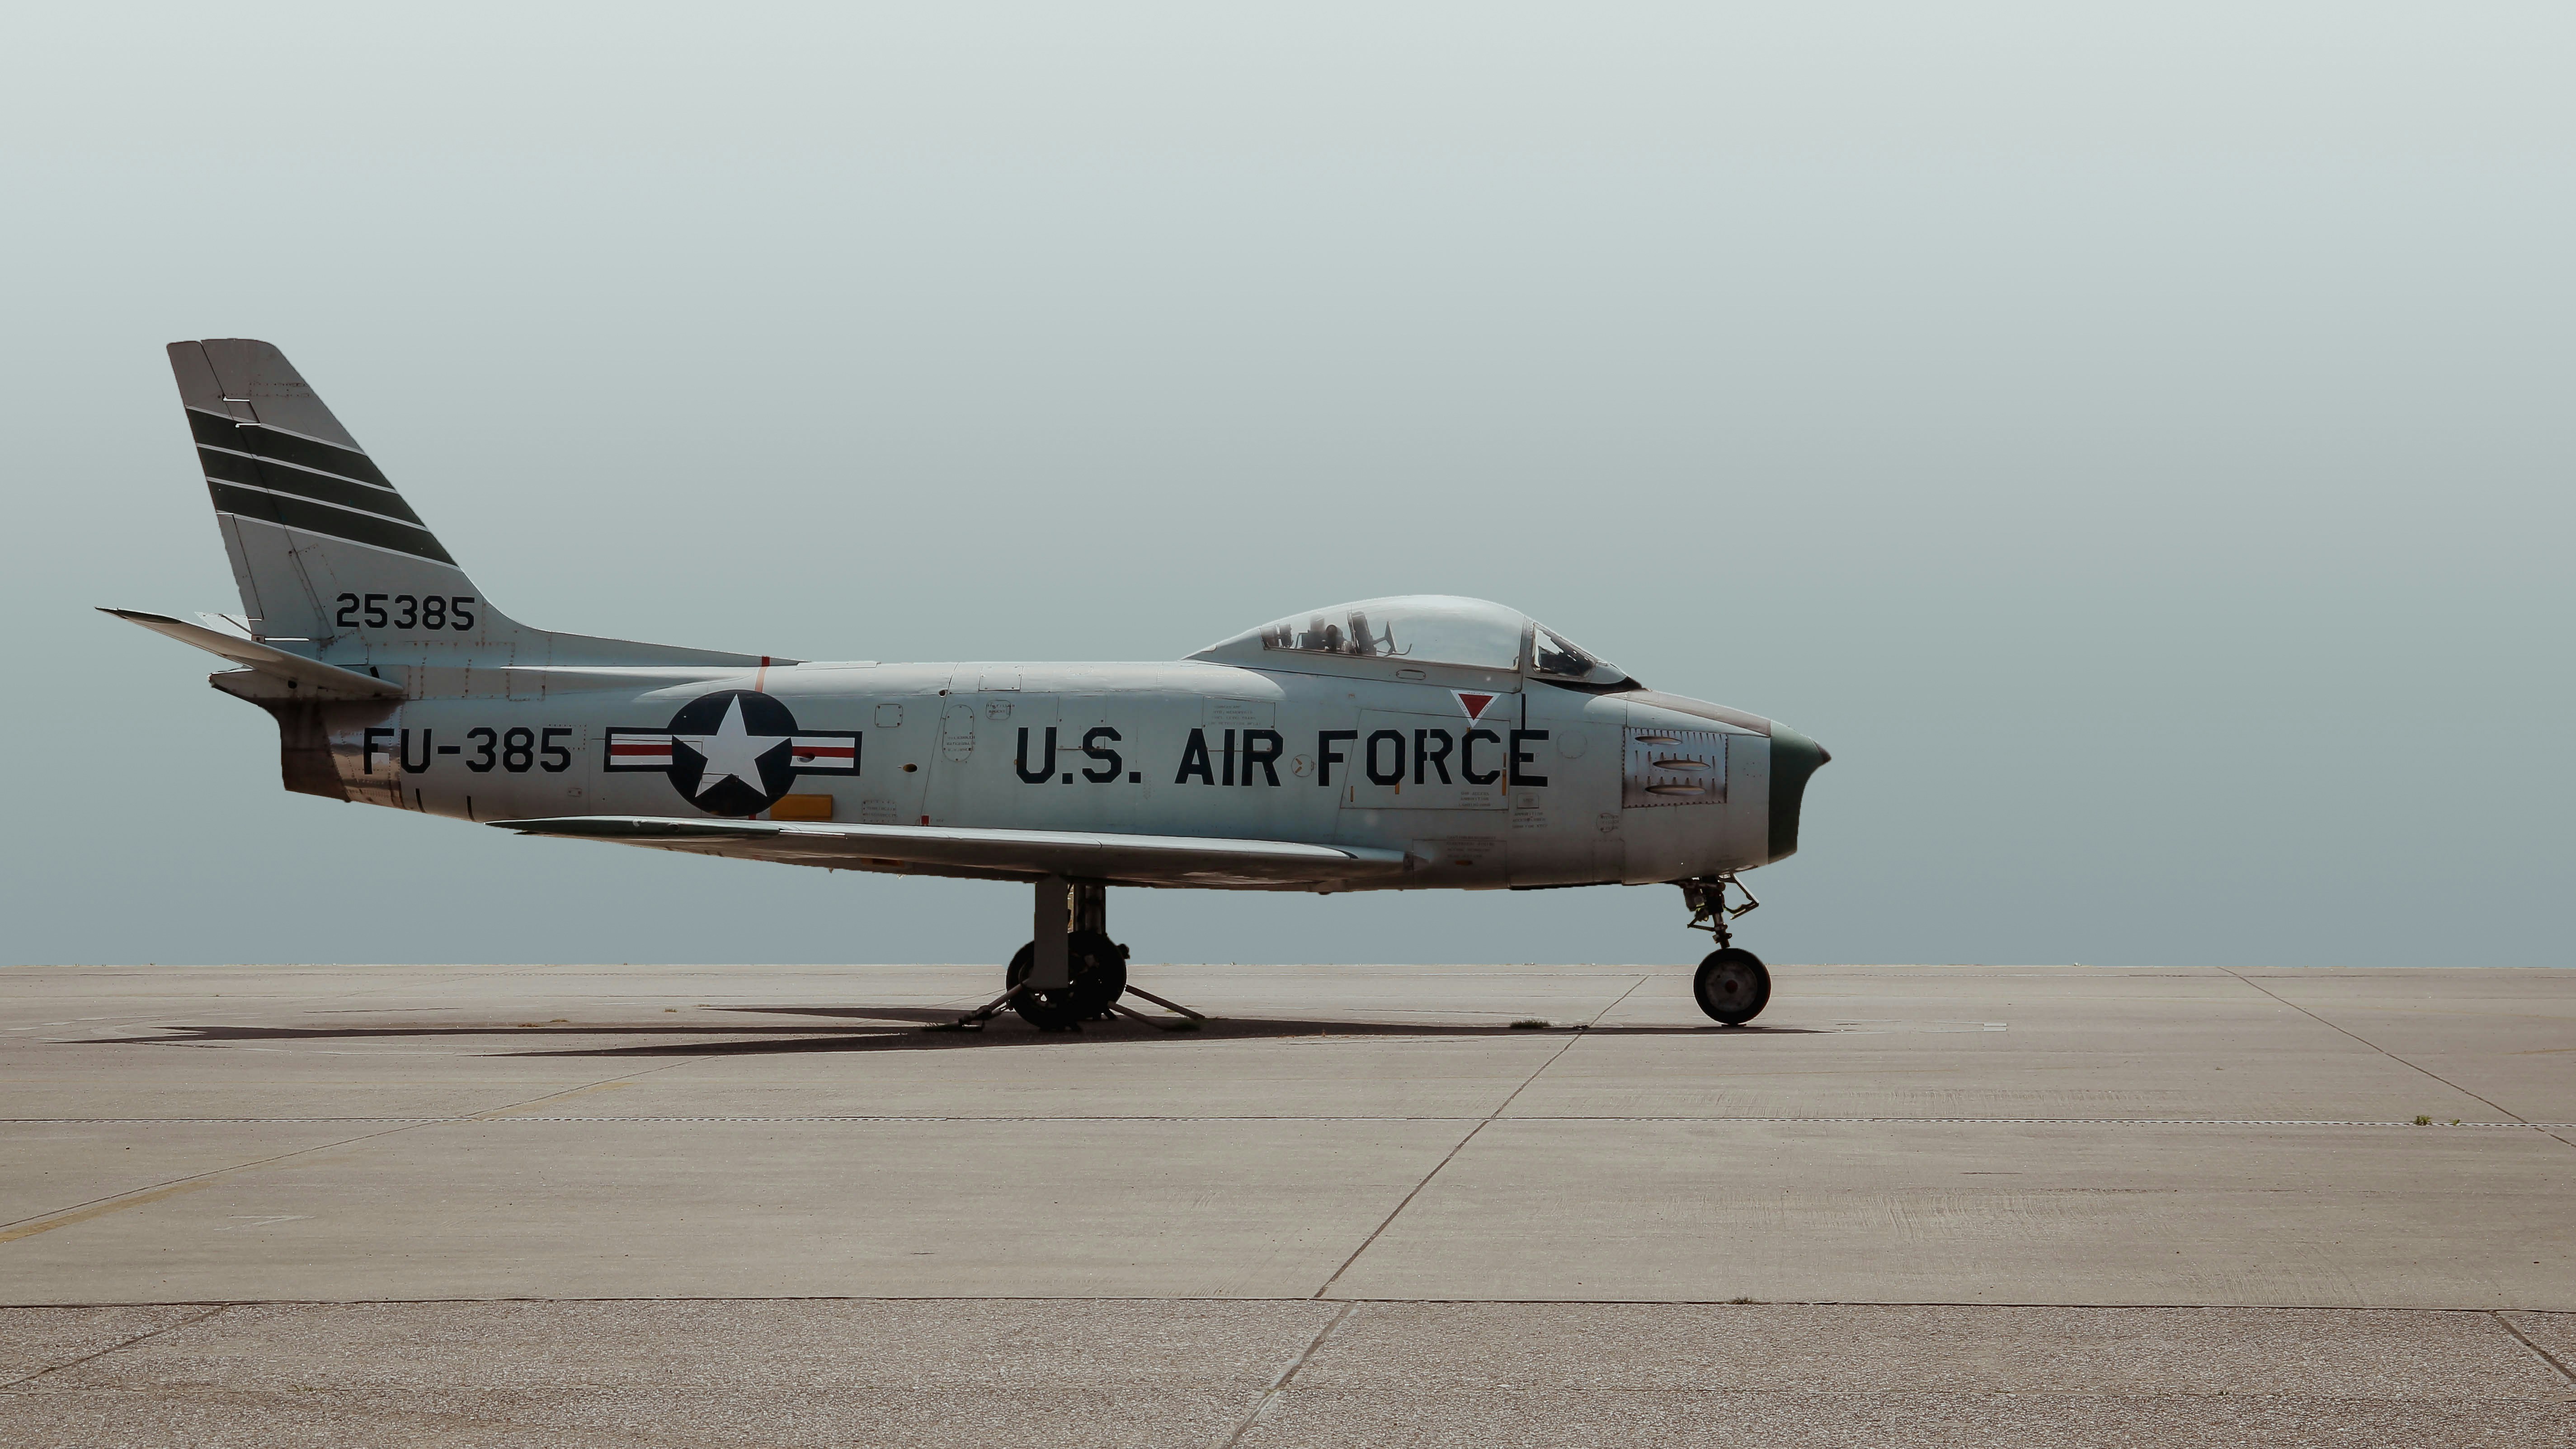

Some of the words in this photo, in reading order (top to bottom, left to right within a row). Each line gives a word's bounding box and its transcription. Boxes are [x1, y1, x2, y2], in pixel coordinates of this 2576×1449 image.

[336, 593, 476, 632] 25385
[363, 727, 573, 775] FU-385
[1016, 726, 1142, 784] U.S.
[1174, 728, 1284, 787] AIR
[1318, 729, 1549, 787] FORCE
